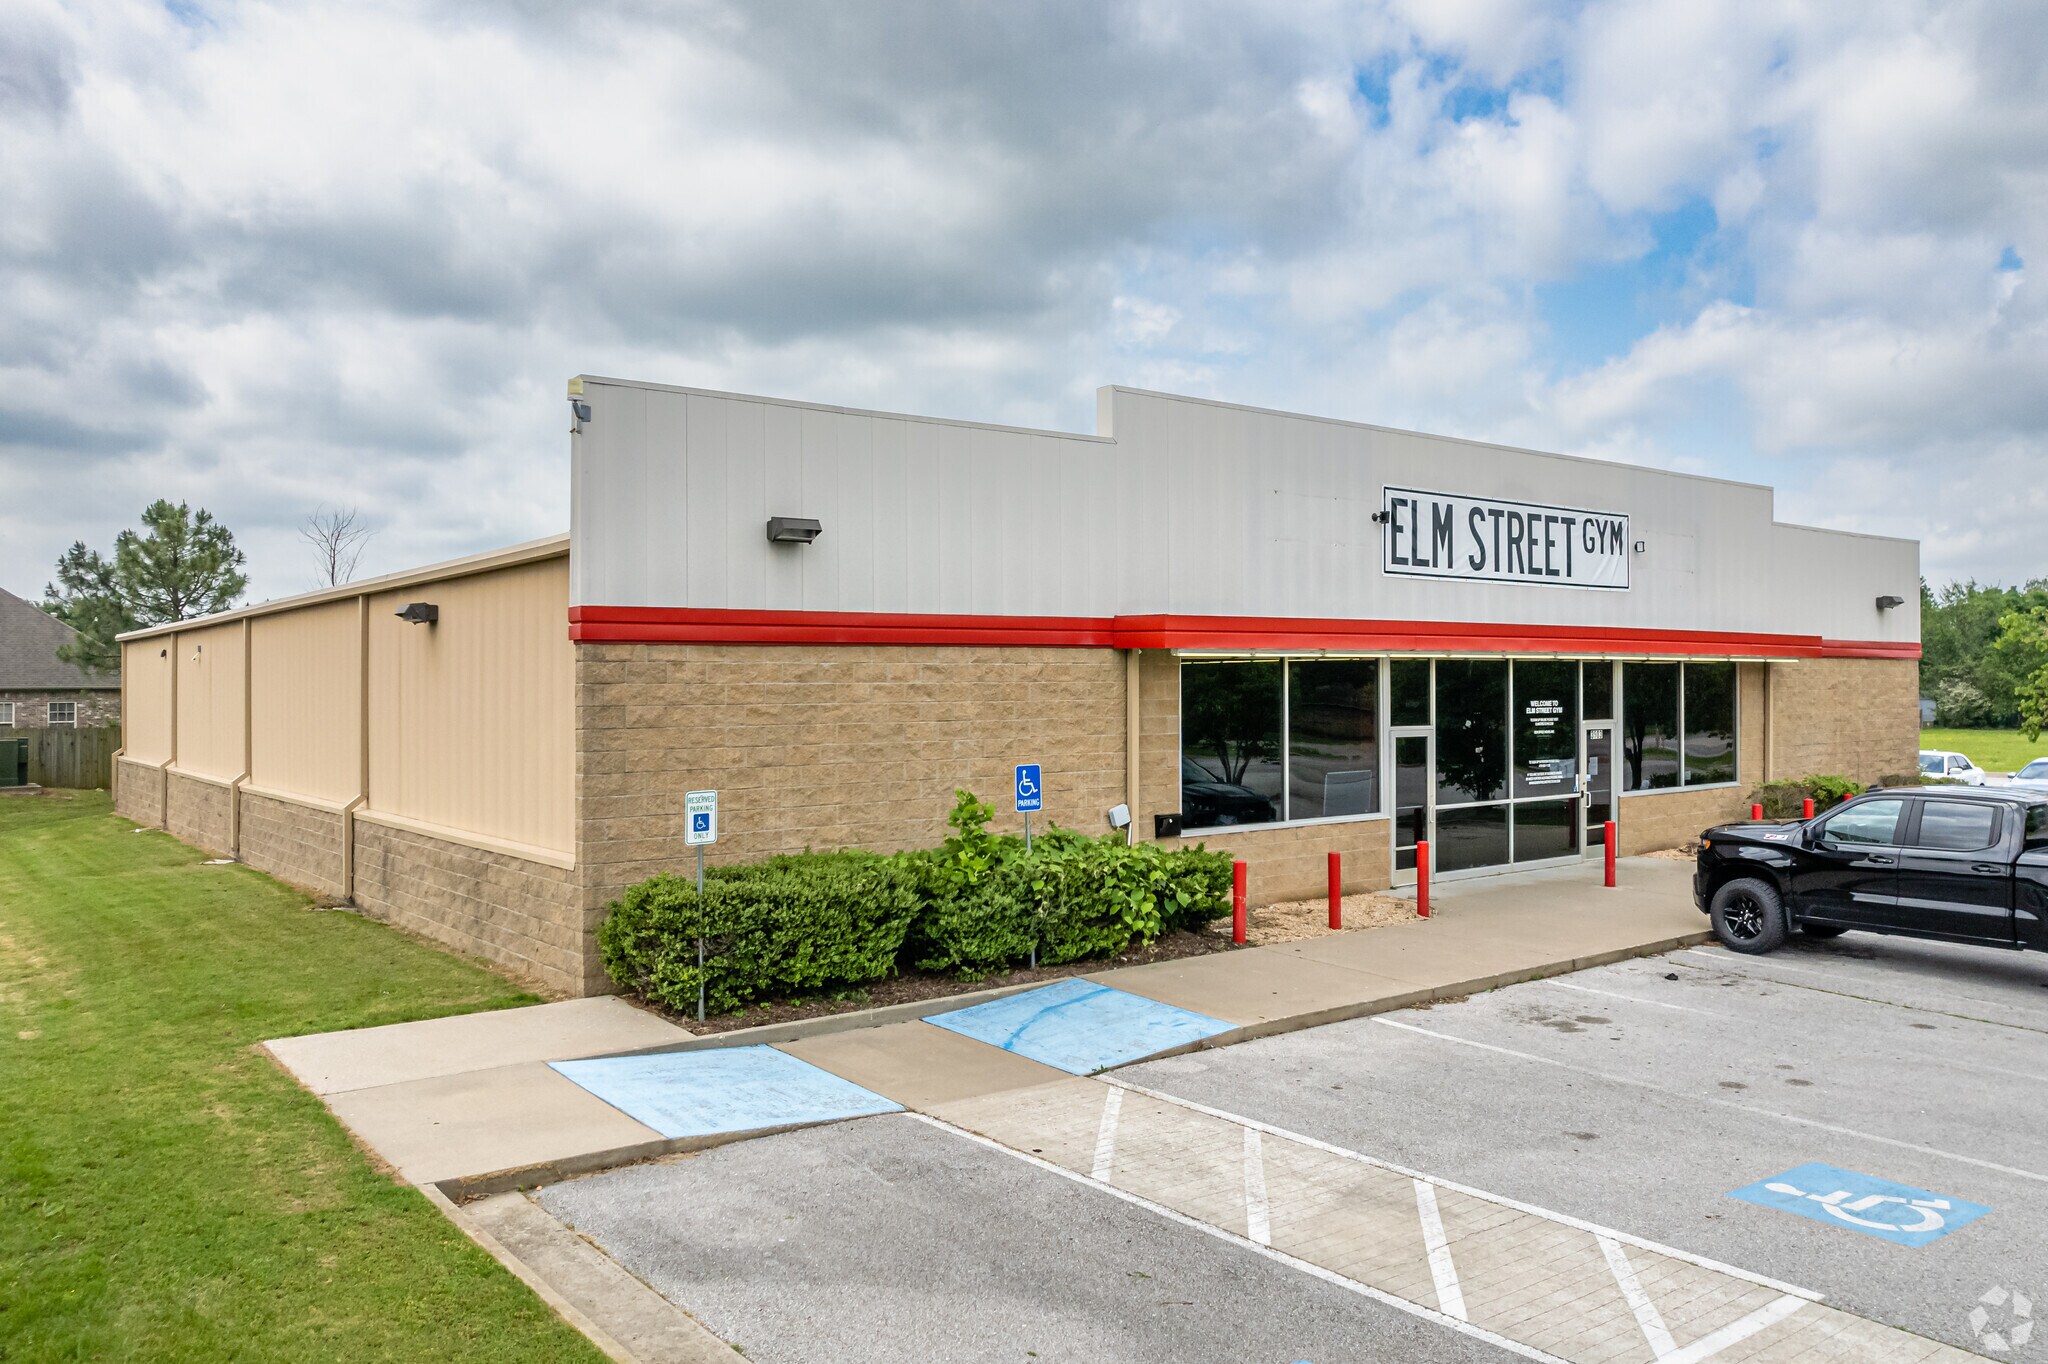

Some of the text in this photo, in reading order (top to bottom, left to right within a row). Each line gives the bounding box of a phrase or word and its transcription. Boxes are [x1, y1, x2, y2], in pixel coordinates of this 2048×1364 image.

[1391, 497, 1624, 578] ELM STREET GYM
[688, 795, 715, 804] RESERVED
[1018, 798, 1040, 807] PARKING
[690, 804, 713, 812] PARKING
[693, 832, 709, 840] ONLY
